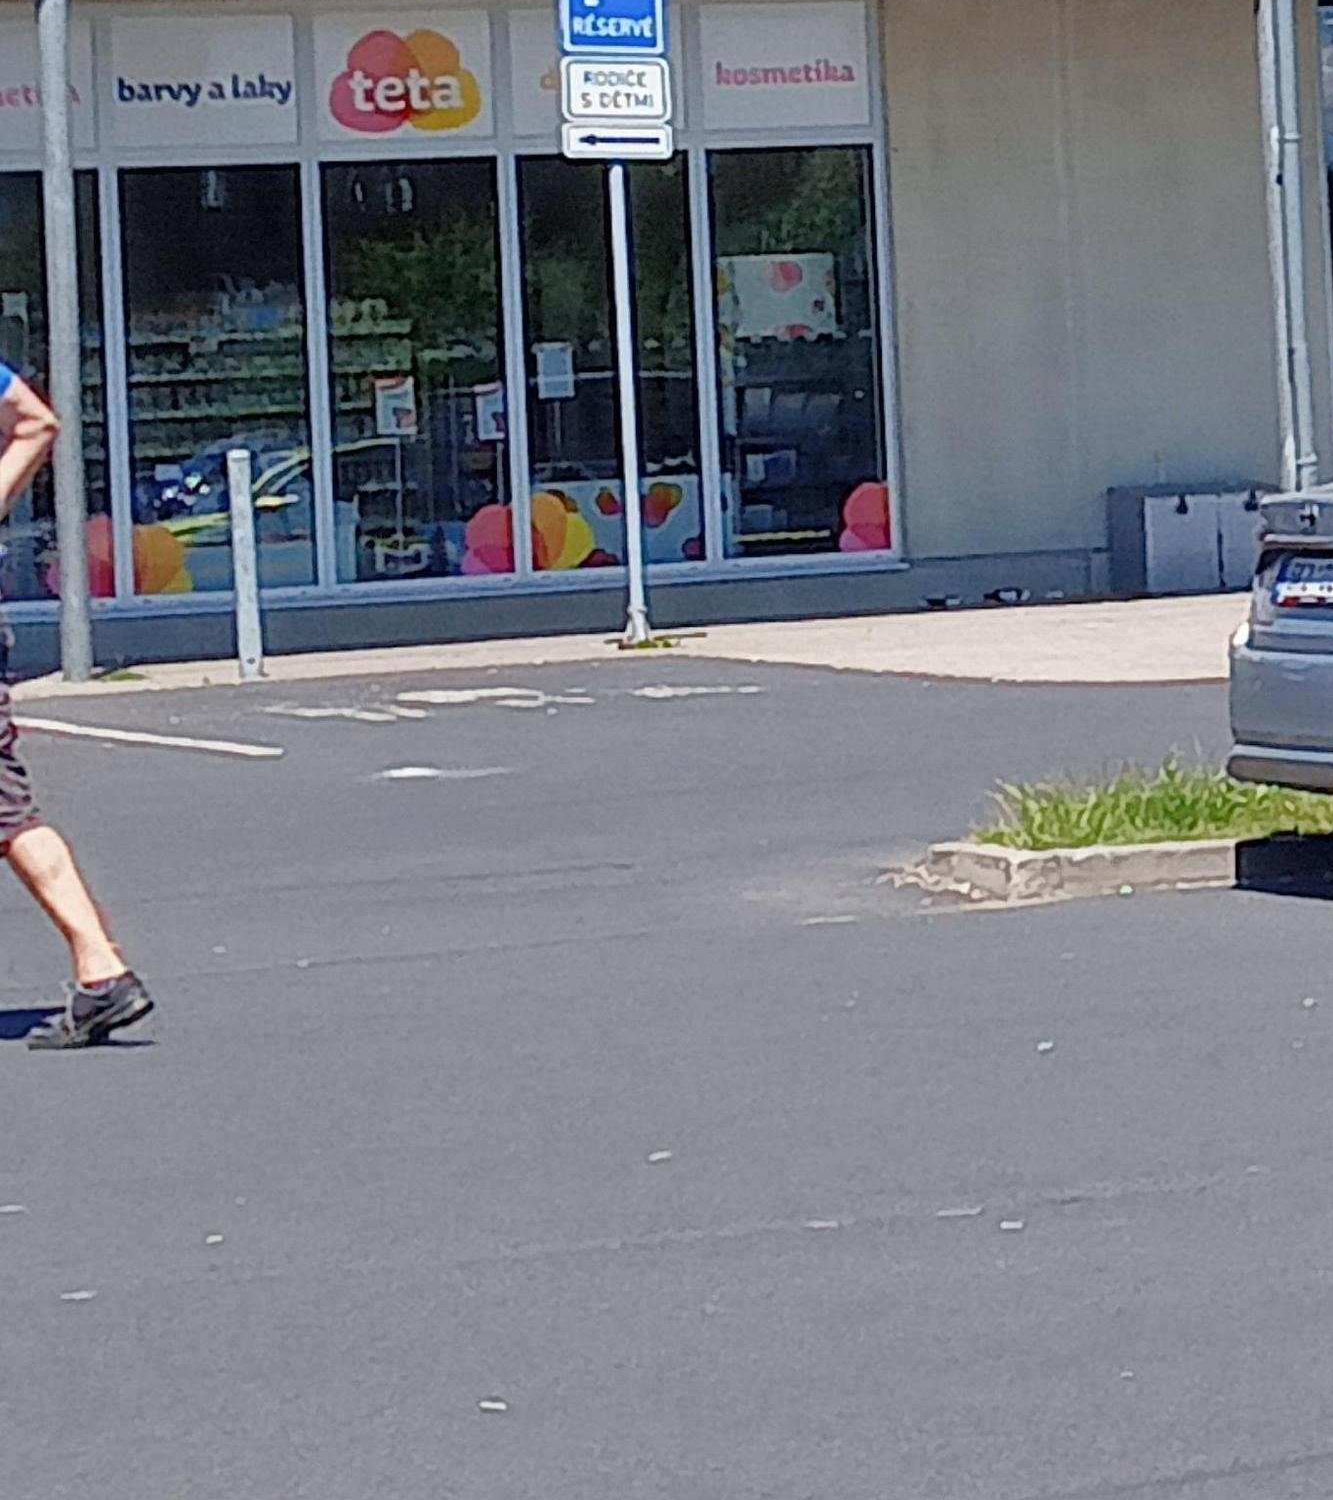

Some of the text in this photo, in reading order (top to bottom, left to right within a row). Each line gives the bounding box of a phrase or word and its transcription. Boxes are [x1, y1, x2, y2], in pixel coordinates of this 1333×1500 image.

[715, 58, 856, 86] kosmetika
[117, 73, 292, 107] barvy a laky
[349, 67, 464, 113] teta
[581, 92, 593, 109] S
